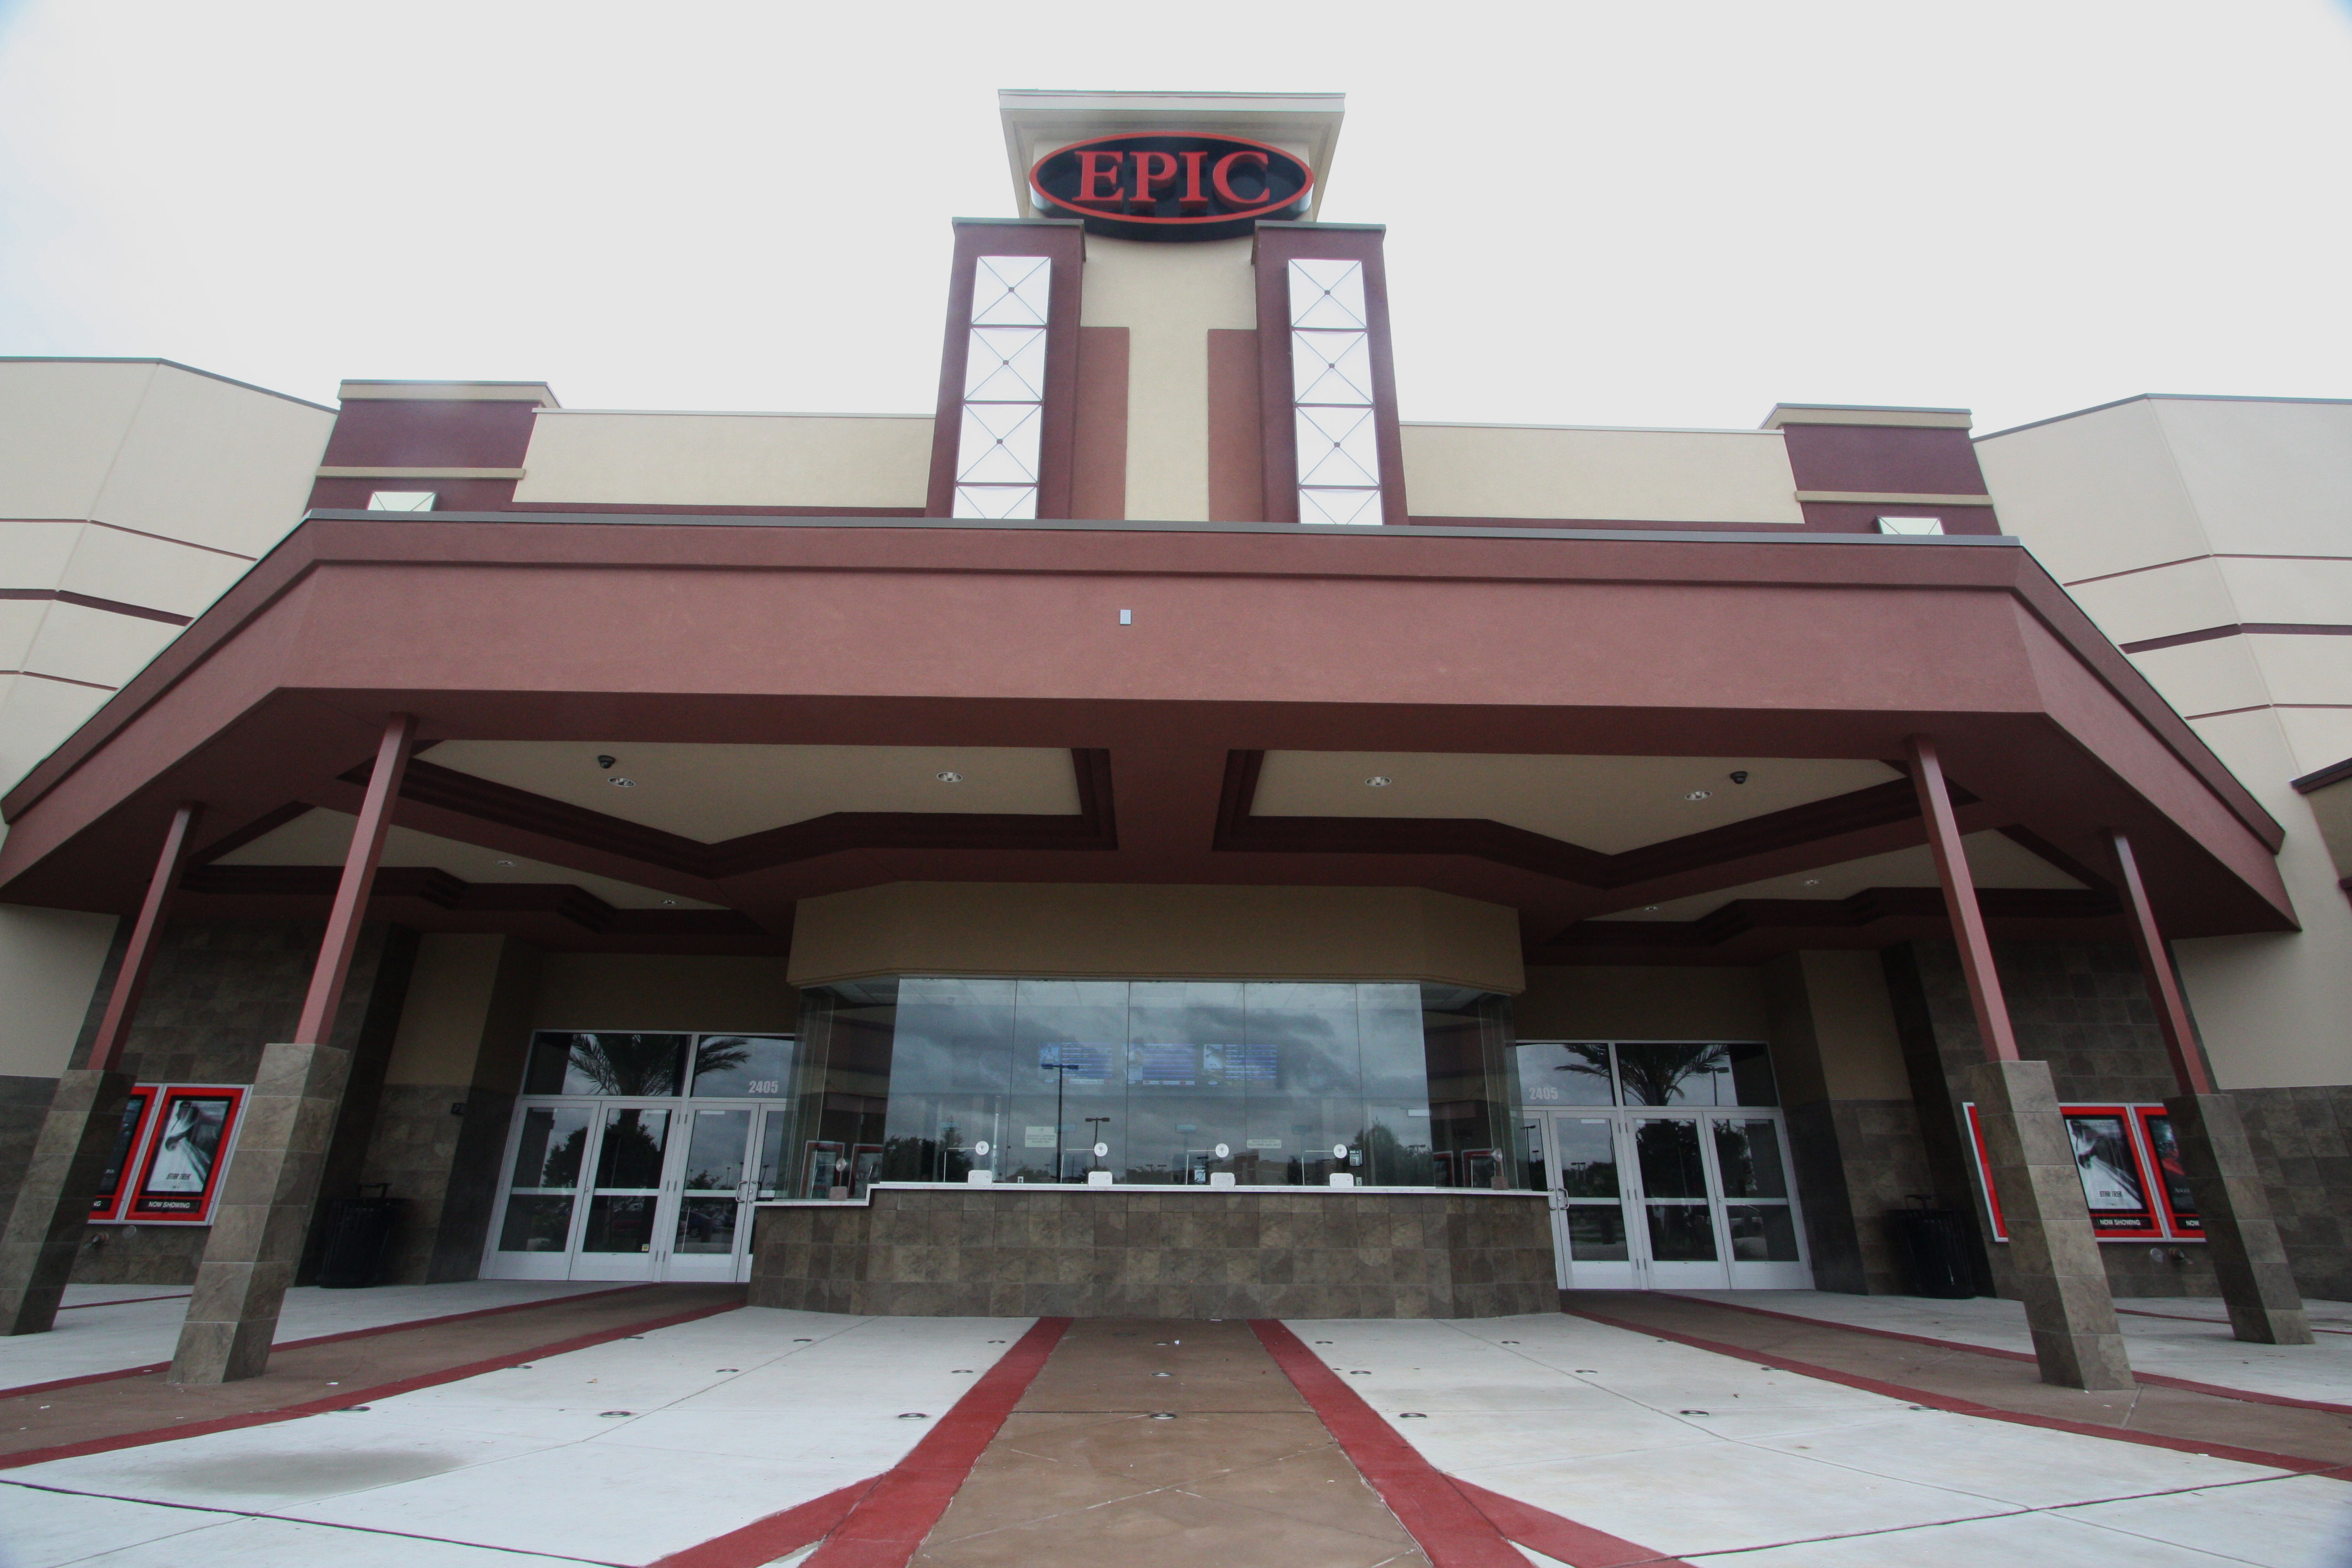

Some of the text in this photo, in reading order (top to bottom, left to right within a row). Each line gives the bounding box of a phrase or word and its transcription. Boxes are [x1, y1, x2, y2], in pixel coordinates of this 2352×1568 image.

[1071, 150, 1271, 208] EPIC
[749, 1080, 778, 1093] 2405
[1529, 1087, 1558, 1100] 2405
